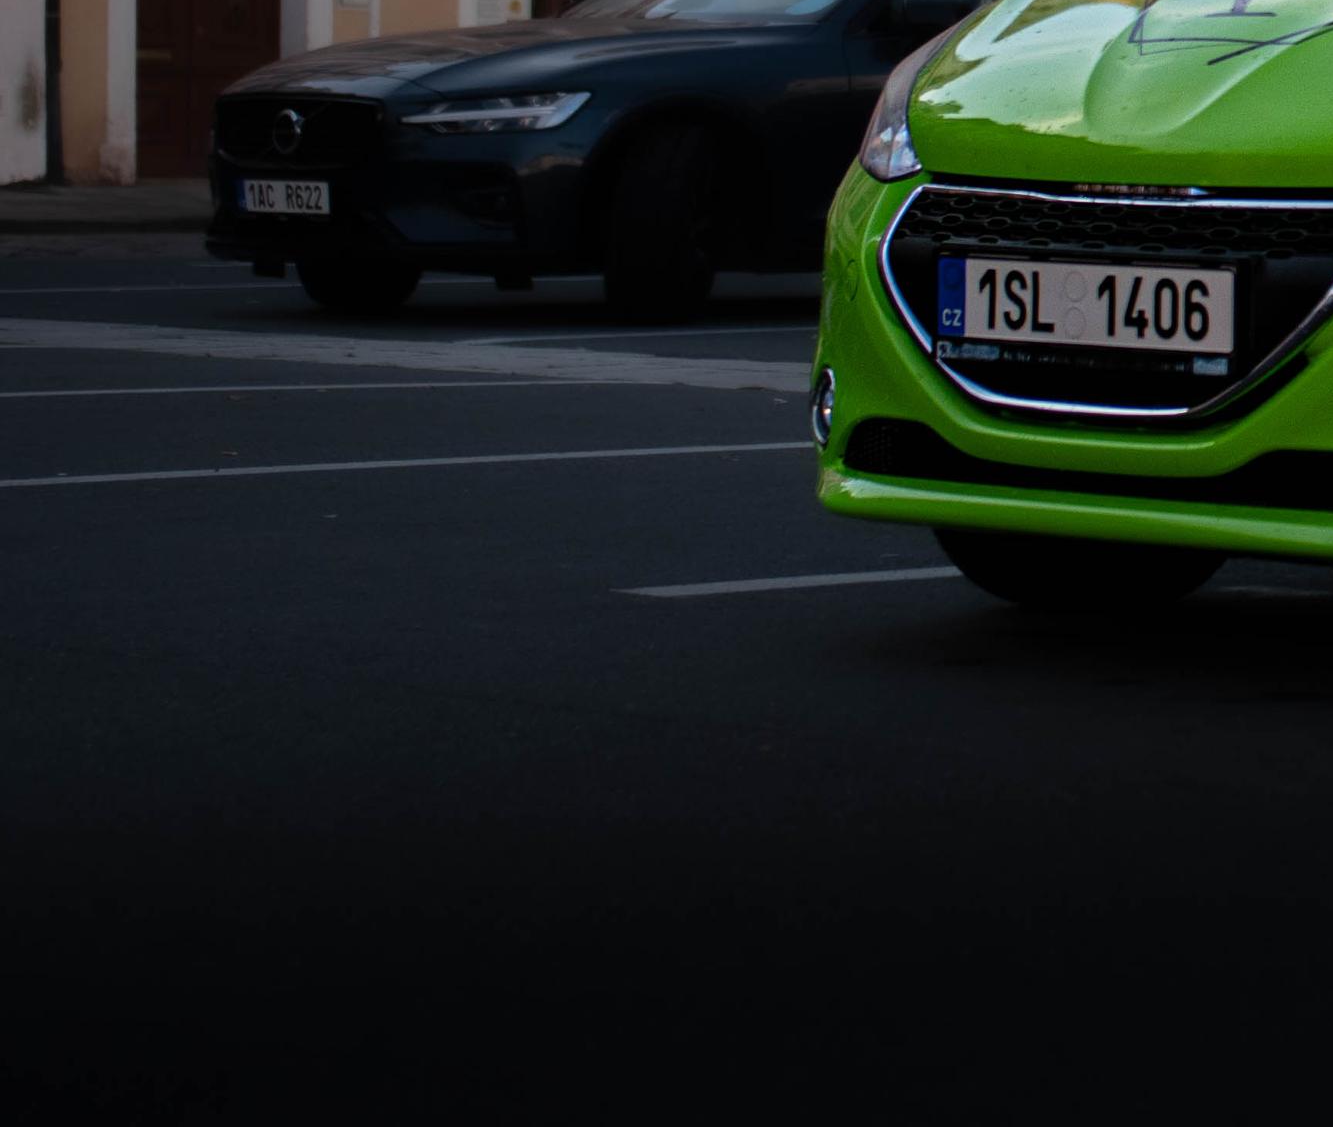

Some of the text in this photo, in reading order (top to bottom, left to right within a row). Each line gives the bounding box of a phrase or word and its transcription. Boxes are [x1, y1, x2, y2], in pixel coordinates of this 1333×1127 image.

[248, 183, 322, 211] 1AC R622
[942, 309, 962, 326] CZ
[978, 268, 1210, 341] 1SL 1406
